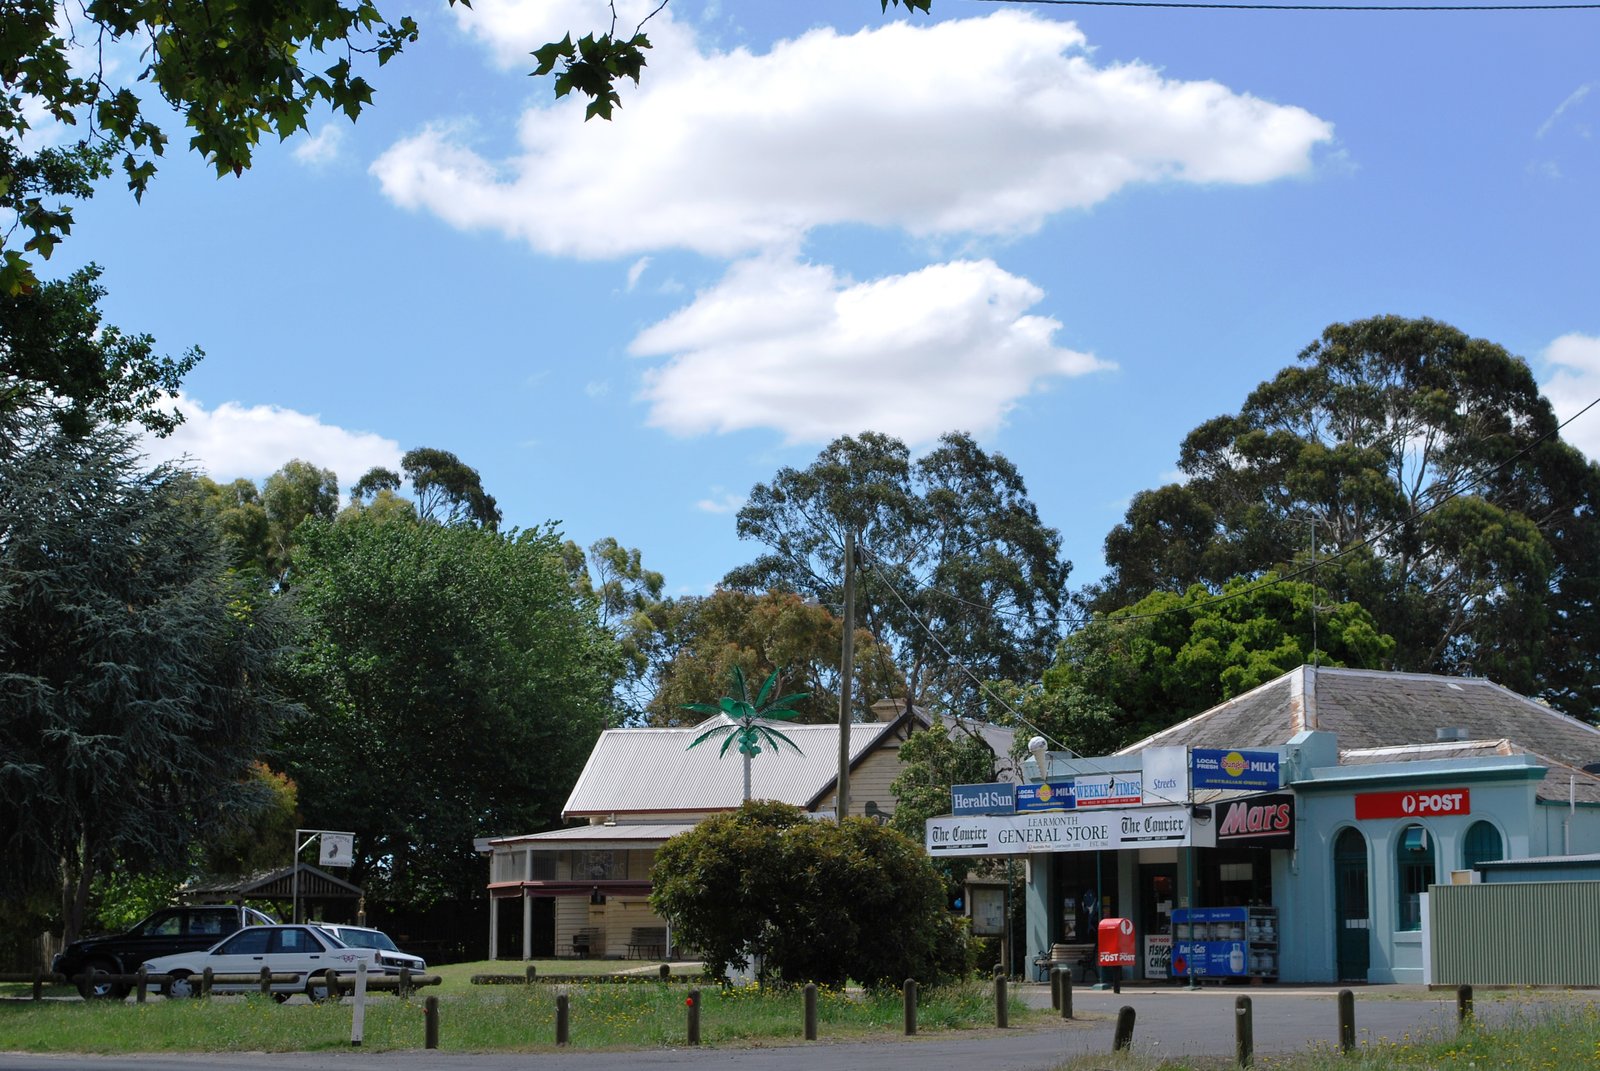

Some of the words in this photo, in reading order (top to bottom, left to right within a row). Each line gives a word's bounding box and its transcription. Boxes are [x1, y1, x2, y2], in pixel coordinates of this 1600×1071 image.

[1251, 761, 1276, 772] MILK
[1056, 787, 1076, 797] MILK
[1076, 784, 1109, 798] WEEKLY
[1115, 781, 1140, 796] TIMES
[1153, 778, 1177, 790] Streets
[954, 792, 990, 809] Herald
[991, 792, 1013, 806] Sun
[1419, 794, 1463, 812] POST
[1028, 816, 1078, 827] LEARMONTH
[1121, 816, 1140, 834] The
[1144, 816, 1184, 833] Courier
[1219, 802, 1290, 836] Mars
[932, 826, 950, 842] The
[952, 826, 988, 842] Courier
[998, 828, 1061, 844] GENERAL
[1066, 825, 1108, 841] STORE
[1100, 954, 1118, 962] POST
